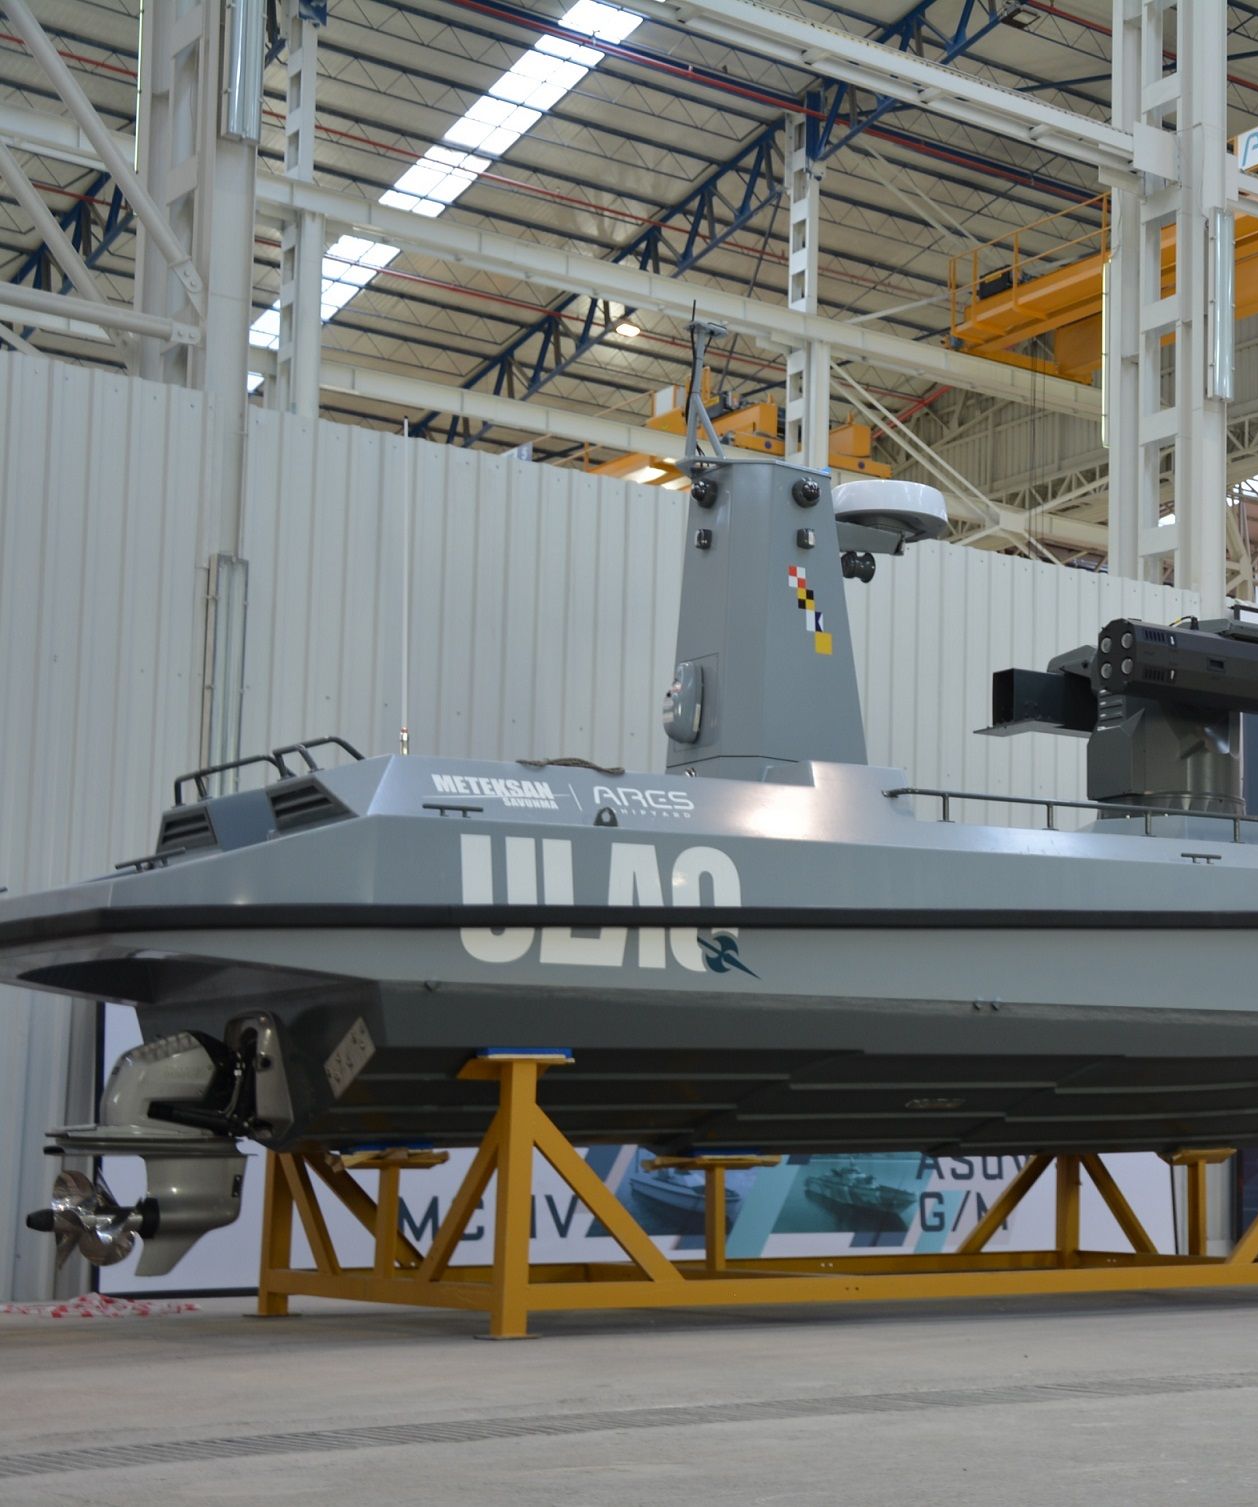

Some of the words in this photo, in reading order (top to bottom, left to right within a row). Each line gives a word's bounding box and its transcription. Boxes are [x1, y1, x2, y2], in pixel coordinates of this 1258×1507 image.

[431, 773, 555, 800] METEKSAN
[592, 785, 695, 811] ARES
[502, 796, 560, 810] SAVUNMA
[459, 833, 757, 979] ULAQ
